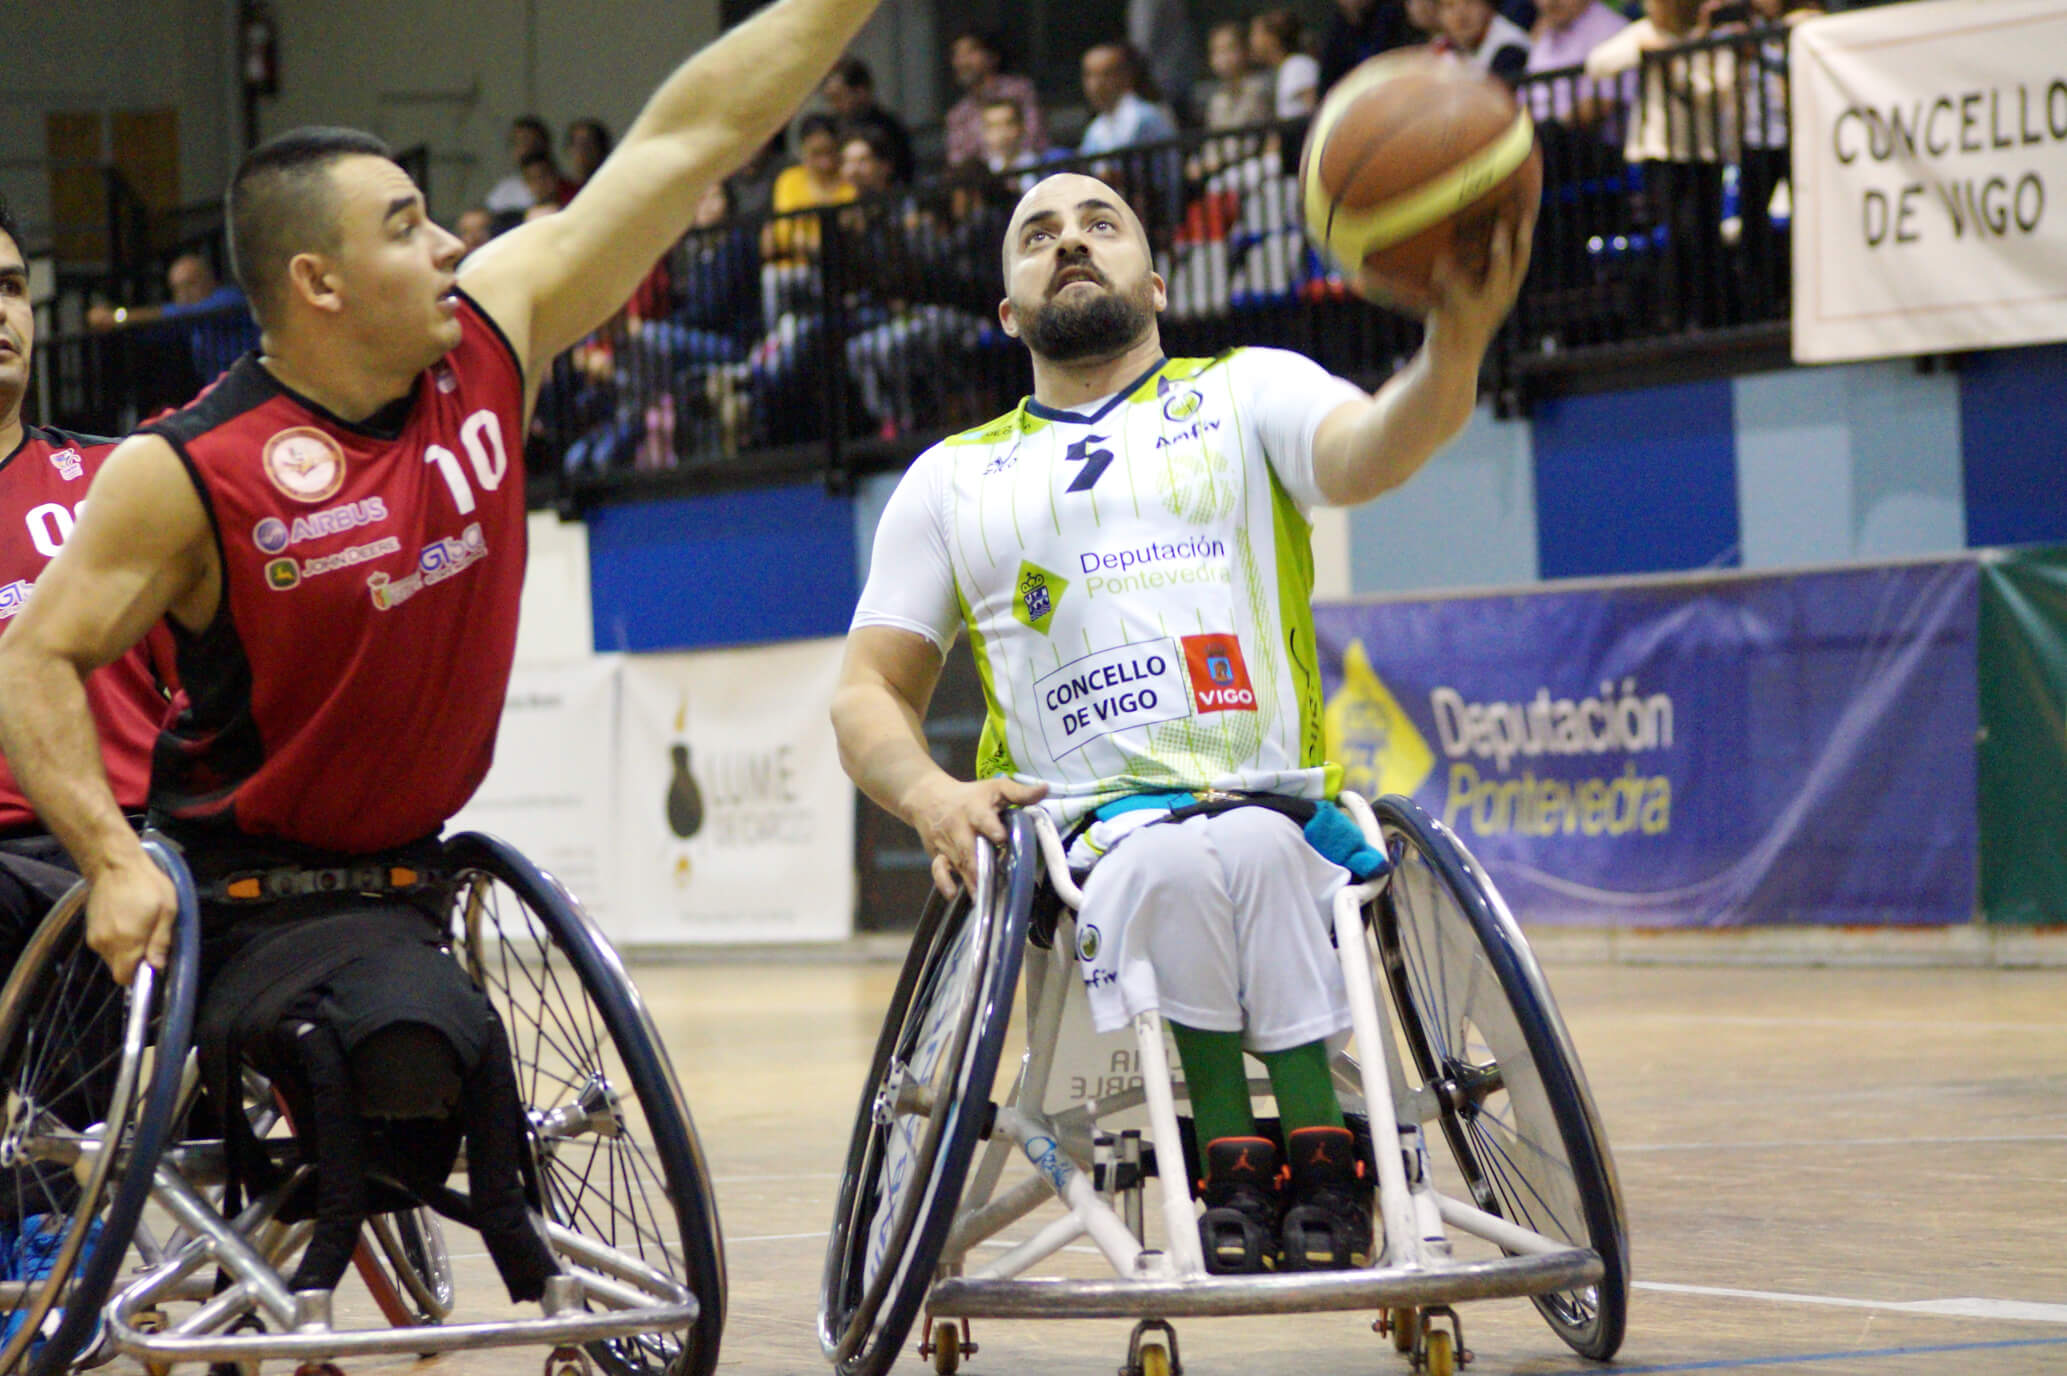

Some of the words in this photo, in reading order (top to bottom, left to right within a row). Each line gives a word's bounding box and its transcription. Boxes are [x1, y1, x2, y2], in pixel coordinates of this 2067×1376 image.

[1834, 79, 2067, 165] CONCELLO
[1862, 182, 1924, 248] DE
[1936, 171, 2045, 239] VIGO
[424, 409, 507, 515] 10
[1065, 434, 1115, 494] 5
[25, 501, 86, 557] 0
[290, 497, 388, 543] AIRBUS
[1079, 535, 1226, 574] Deputación
[1085, 564, 1232, 599] Pontevedra
[1045, 655, 1167, 711] CONCELLO
[1198, 687, 1255, 705] VIGO
[1061, 708, 1091, 736] DE
[1093, 688, 1158, 721] VIGO
[1431, 677, 1674, 771] Deputación
[1443, 763, 1672, 838] Pontevedra
